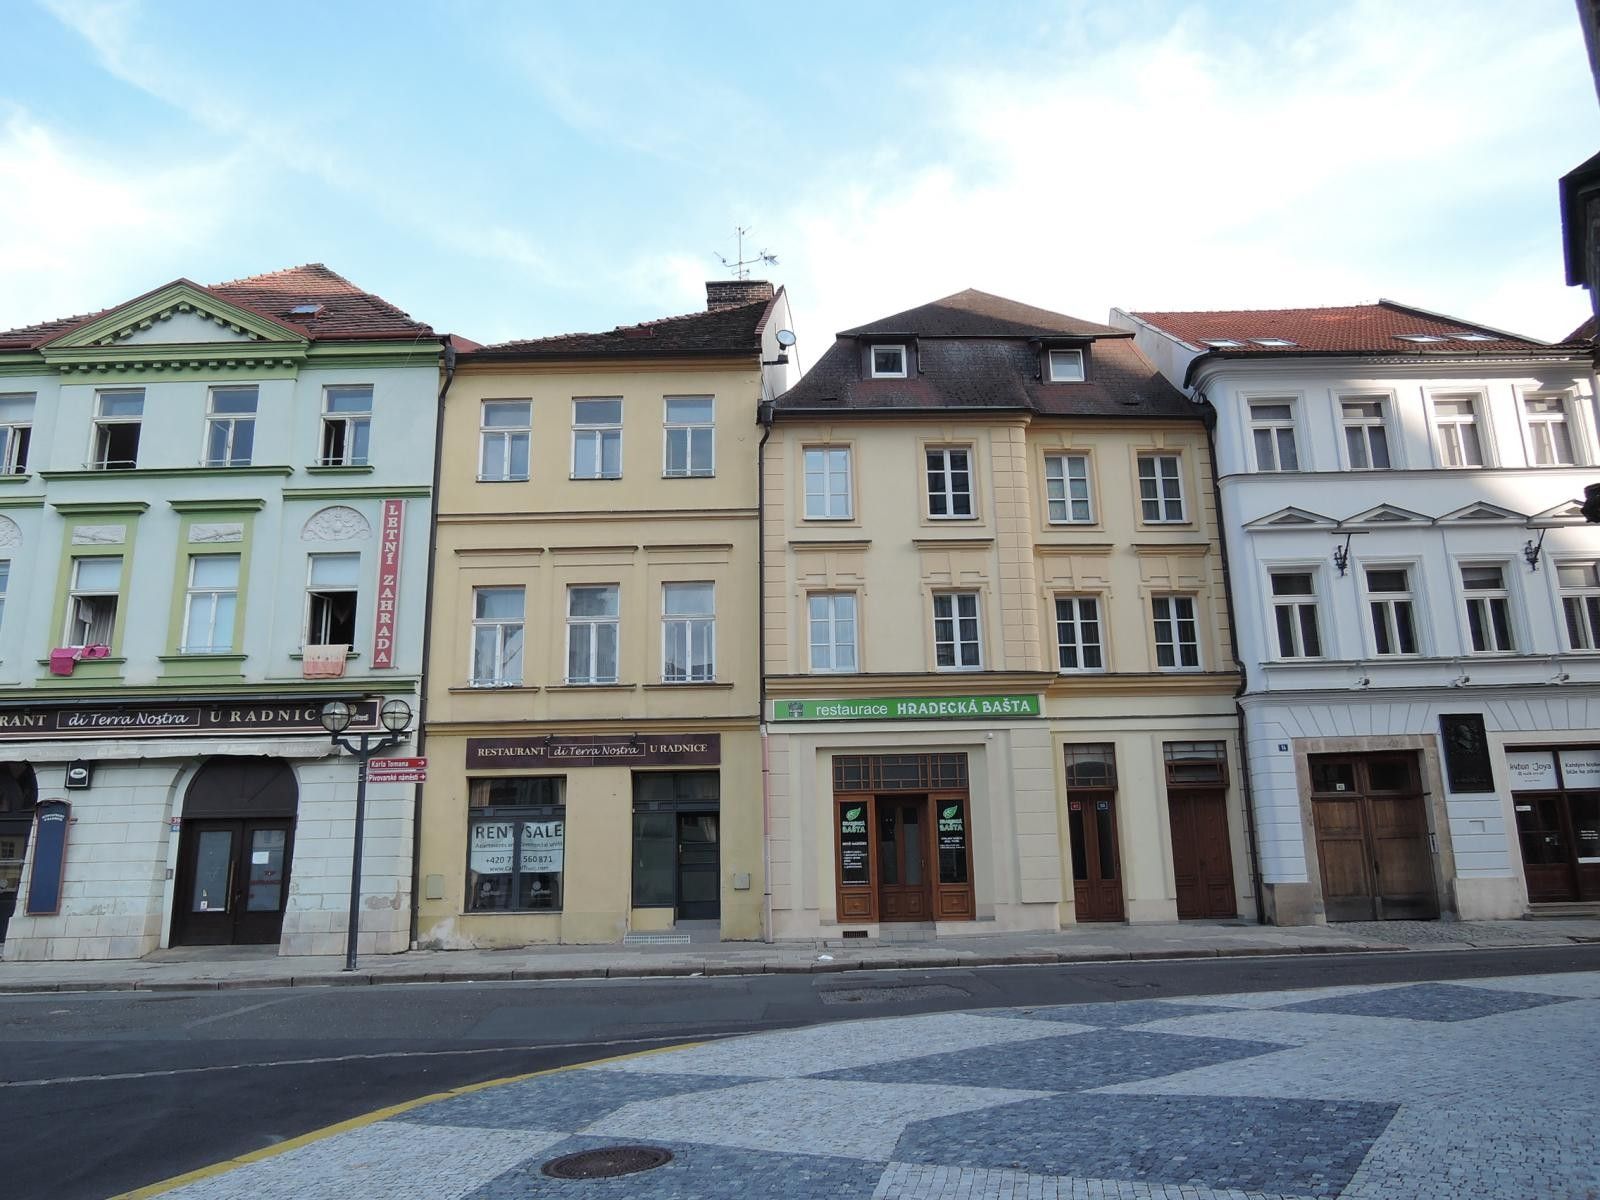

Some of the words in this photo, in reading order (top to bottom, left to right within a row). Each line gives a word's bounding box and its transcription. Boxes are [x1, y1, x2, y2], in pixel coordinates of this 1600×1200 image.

[384, 505, 398, 565] LETNÍ
[376, 575, 394, 663] ZAHRADA
[816, 703, 888, 716] restaurace
[897, 699, 978, 715] HRADECKÁ
[982, 698, 1031, 713] BAŠTA
[69, 713, 88, 726] di
[91, 713, 134, 725] Terra
[136, 711, 189, 725] Nostra
[210, 711, 222, 722] U
[230, 709, 320, 722] RADNIC
[478, 747, 545, 757] RESTAURANT
[554, 746, 568, 756] di
[569, 746, 600, 756] Terra
[601, 746, 639, 755] Nostra
[650, 744, 658, 753] U
[660, 743, 708, 753] RADNICE
[371, 760, 386, 768] Karla
[387, 760, 409, 768] Tomana
[368, 773, 397, 782] Pivovarské
[523, 855, 537, 863] 560
[539, 855, 553, 863] 871
